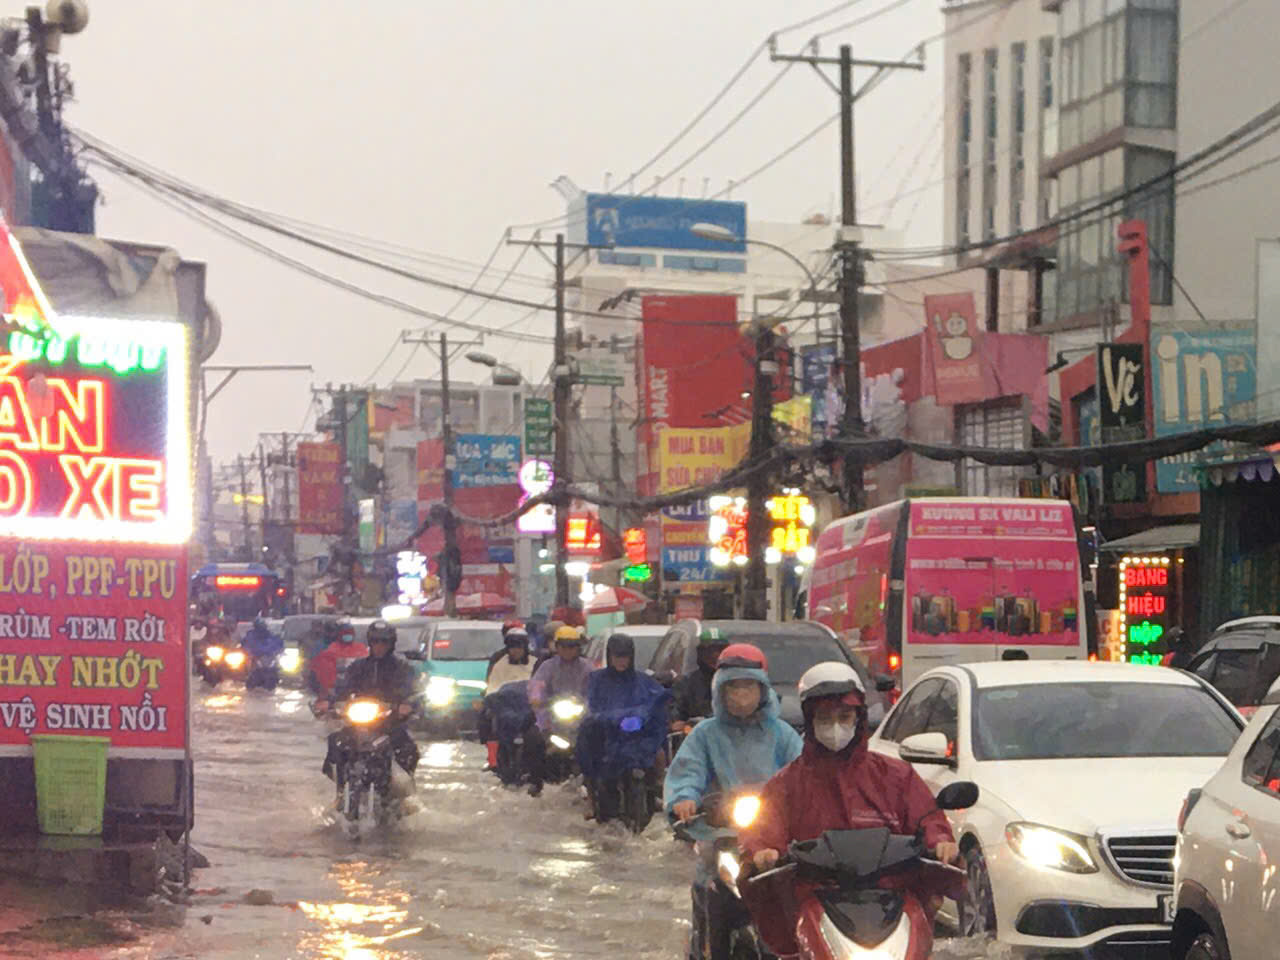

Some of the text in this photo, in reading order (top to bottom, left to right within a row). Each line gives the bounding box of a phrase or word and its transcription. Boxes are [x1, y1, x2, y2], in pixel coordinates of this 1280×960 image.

[1157, 335, 1224, 422] in
[58, 454, 165, 520] XE
[65, 555, 176, 599] PPF-TPU
[1127, 591, 1165, 617] HIỆU
[124, 613, 166, 642] RỜI
[71, 648, 165, 689] NHỚT
[0, 692, 168, 735] VỆ SINH NỒI
